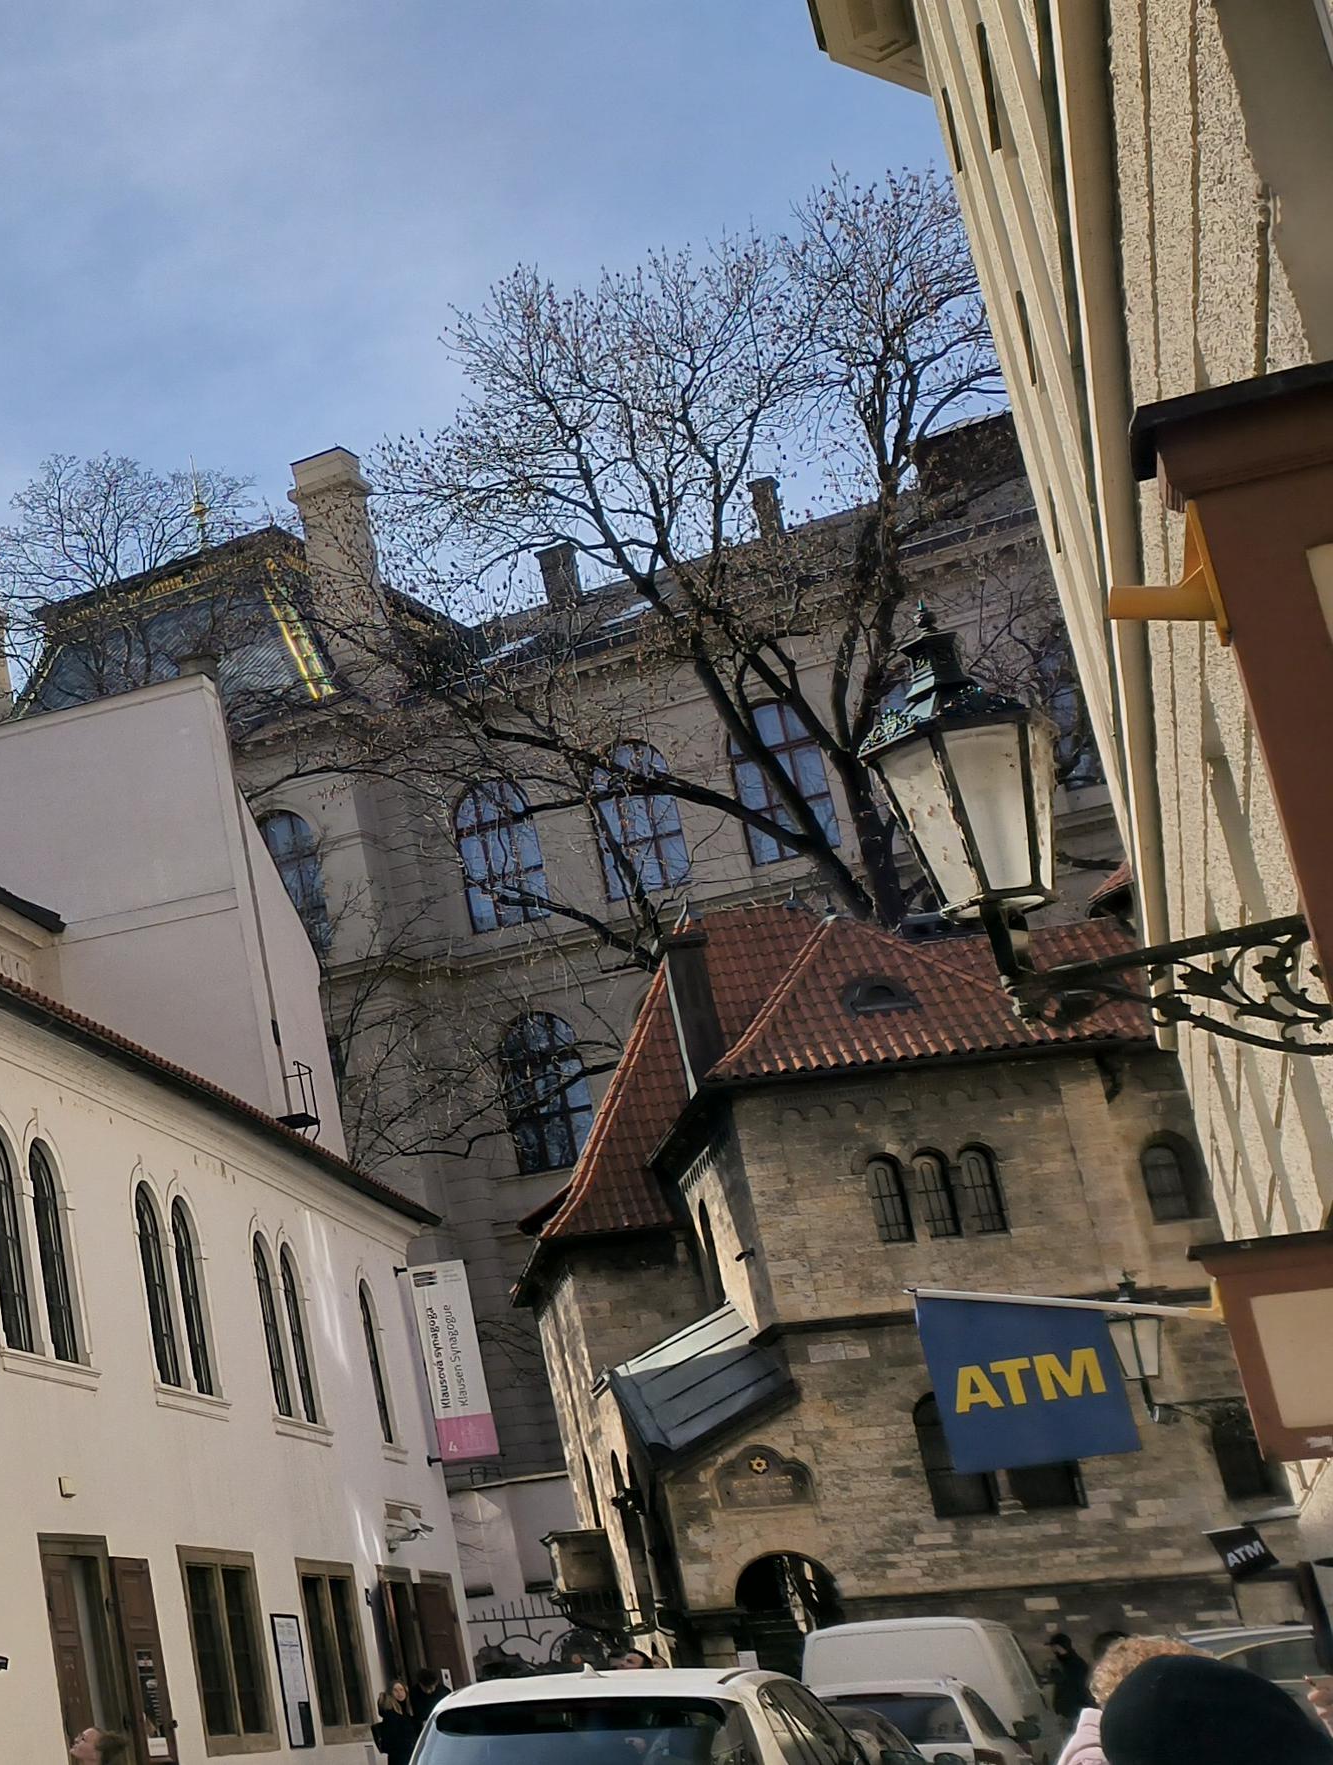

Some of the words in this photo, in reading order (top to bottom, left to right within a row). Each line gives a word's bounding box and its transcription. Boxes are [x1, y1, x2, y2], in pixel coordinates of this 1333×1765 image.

[426, 1307, 444, 1359] synagoga
[444, 1304, 461, 1364] Synagogue
[434, 1359, 451, 1409] Klausová
[452, 1364, 468, 1407] Klausen
[956, 1347, 1106, 1413] ATM
[1225, 1540, 1264, 1567] ATM
